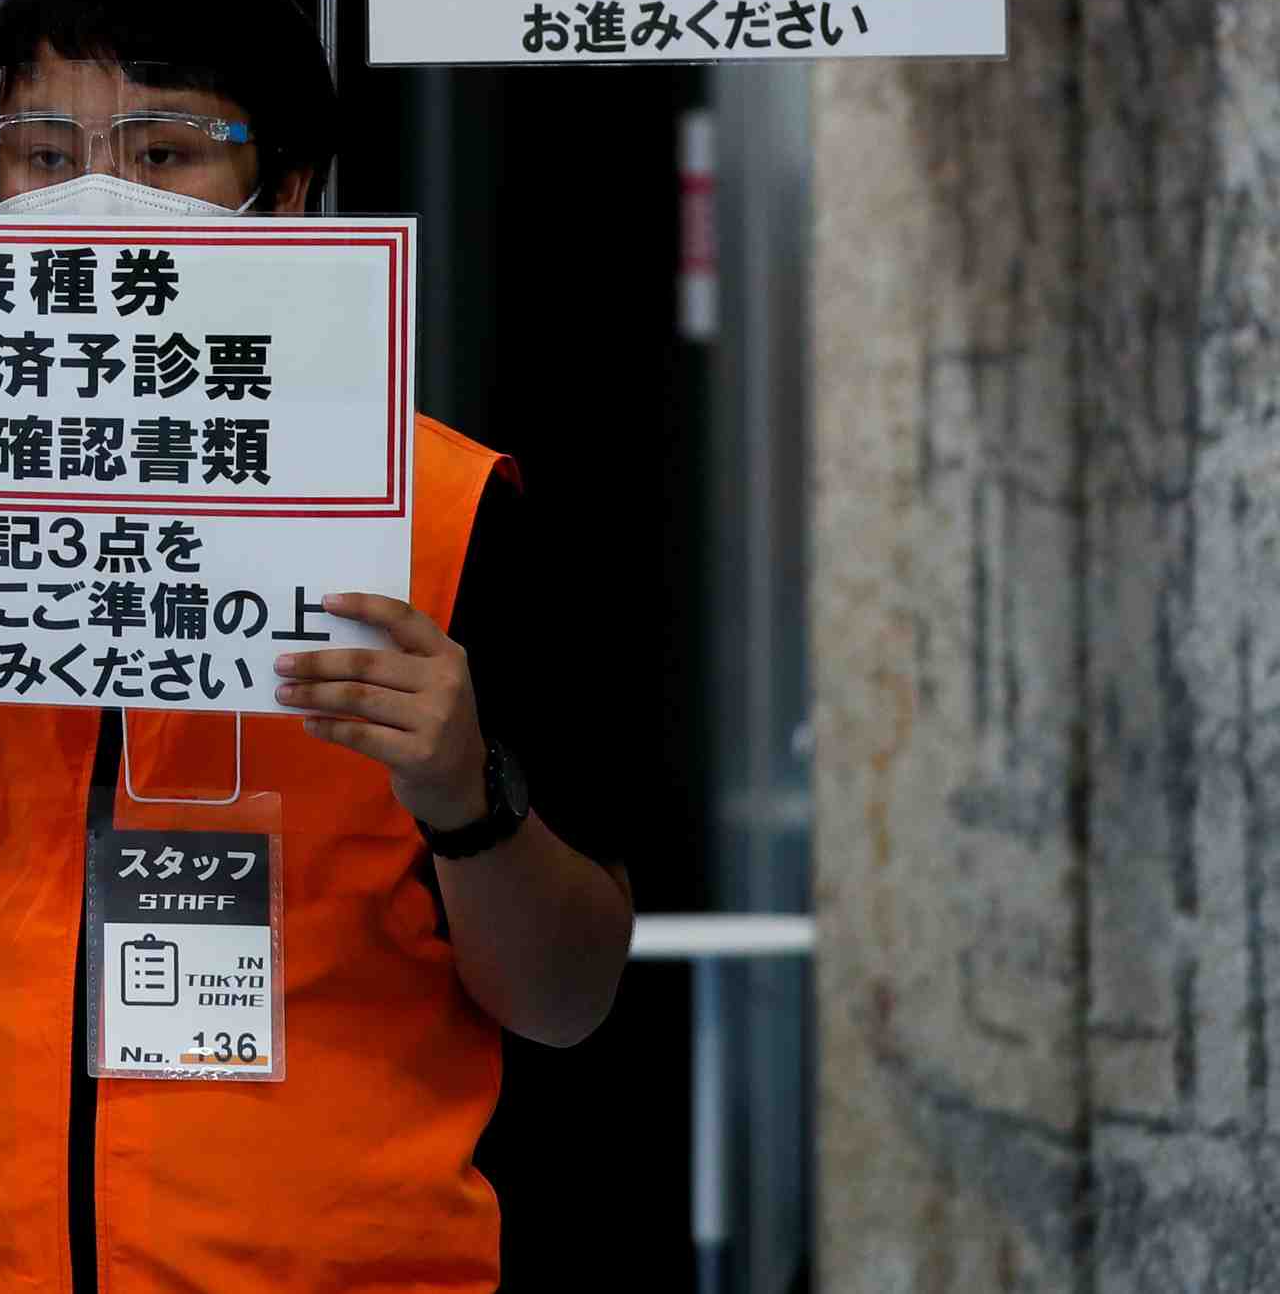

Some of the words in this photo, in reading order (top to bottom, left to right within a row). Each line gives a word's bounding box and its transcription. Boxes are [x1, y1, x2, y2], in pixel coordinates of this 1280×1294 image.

[521, 0, 870, 54] お進みください
[118, 845, 257, 882] スタッフ
[138, 893, 236, 911] STAFF
[237, 956, 264, 970] IN
[184, 972, 265, 989] TOKYO
[197, 993, 265, 1008] DOME
[120, 1046, 171, 1064] No.
[192, 1031, 258, 1063] 136
